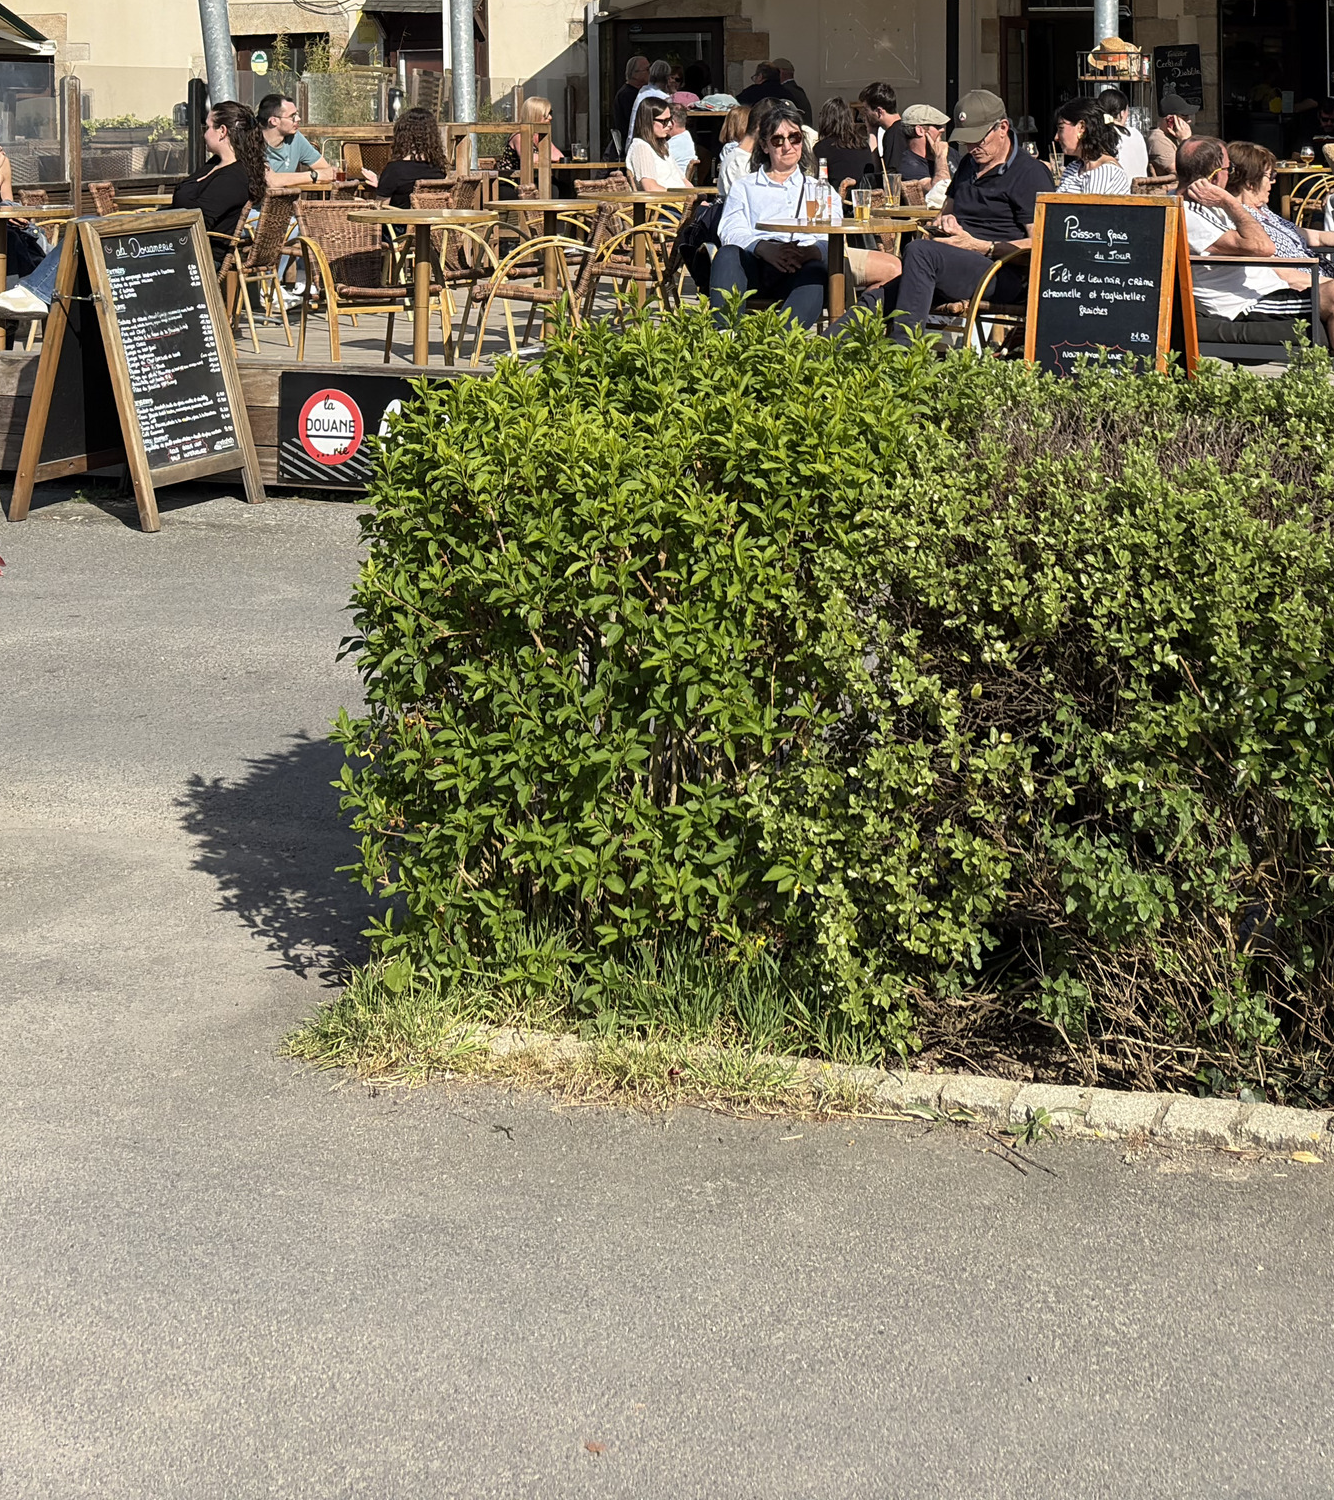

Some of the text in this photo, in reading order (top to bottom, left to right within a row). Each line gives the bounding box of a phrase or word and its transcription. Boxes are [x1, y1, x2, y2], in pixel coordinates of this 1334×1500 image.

[1063, 215, 1102, 240] Poisson
[1094, 251, 1105, 260] du
[1049, 263, 1072, 282] Filet
[1075, 272, 1086, 282] de
[1042, 288, 1146, 303] citronnelle et tagliatelles
[323, 394, 335, 410] la
[305, 417, 355, 433] DOUANE
